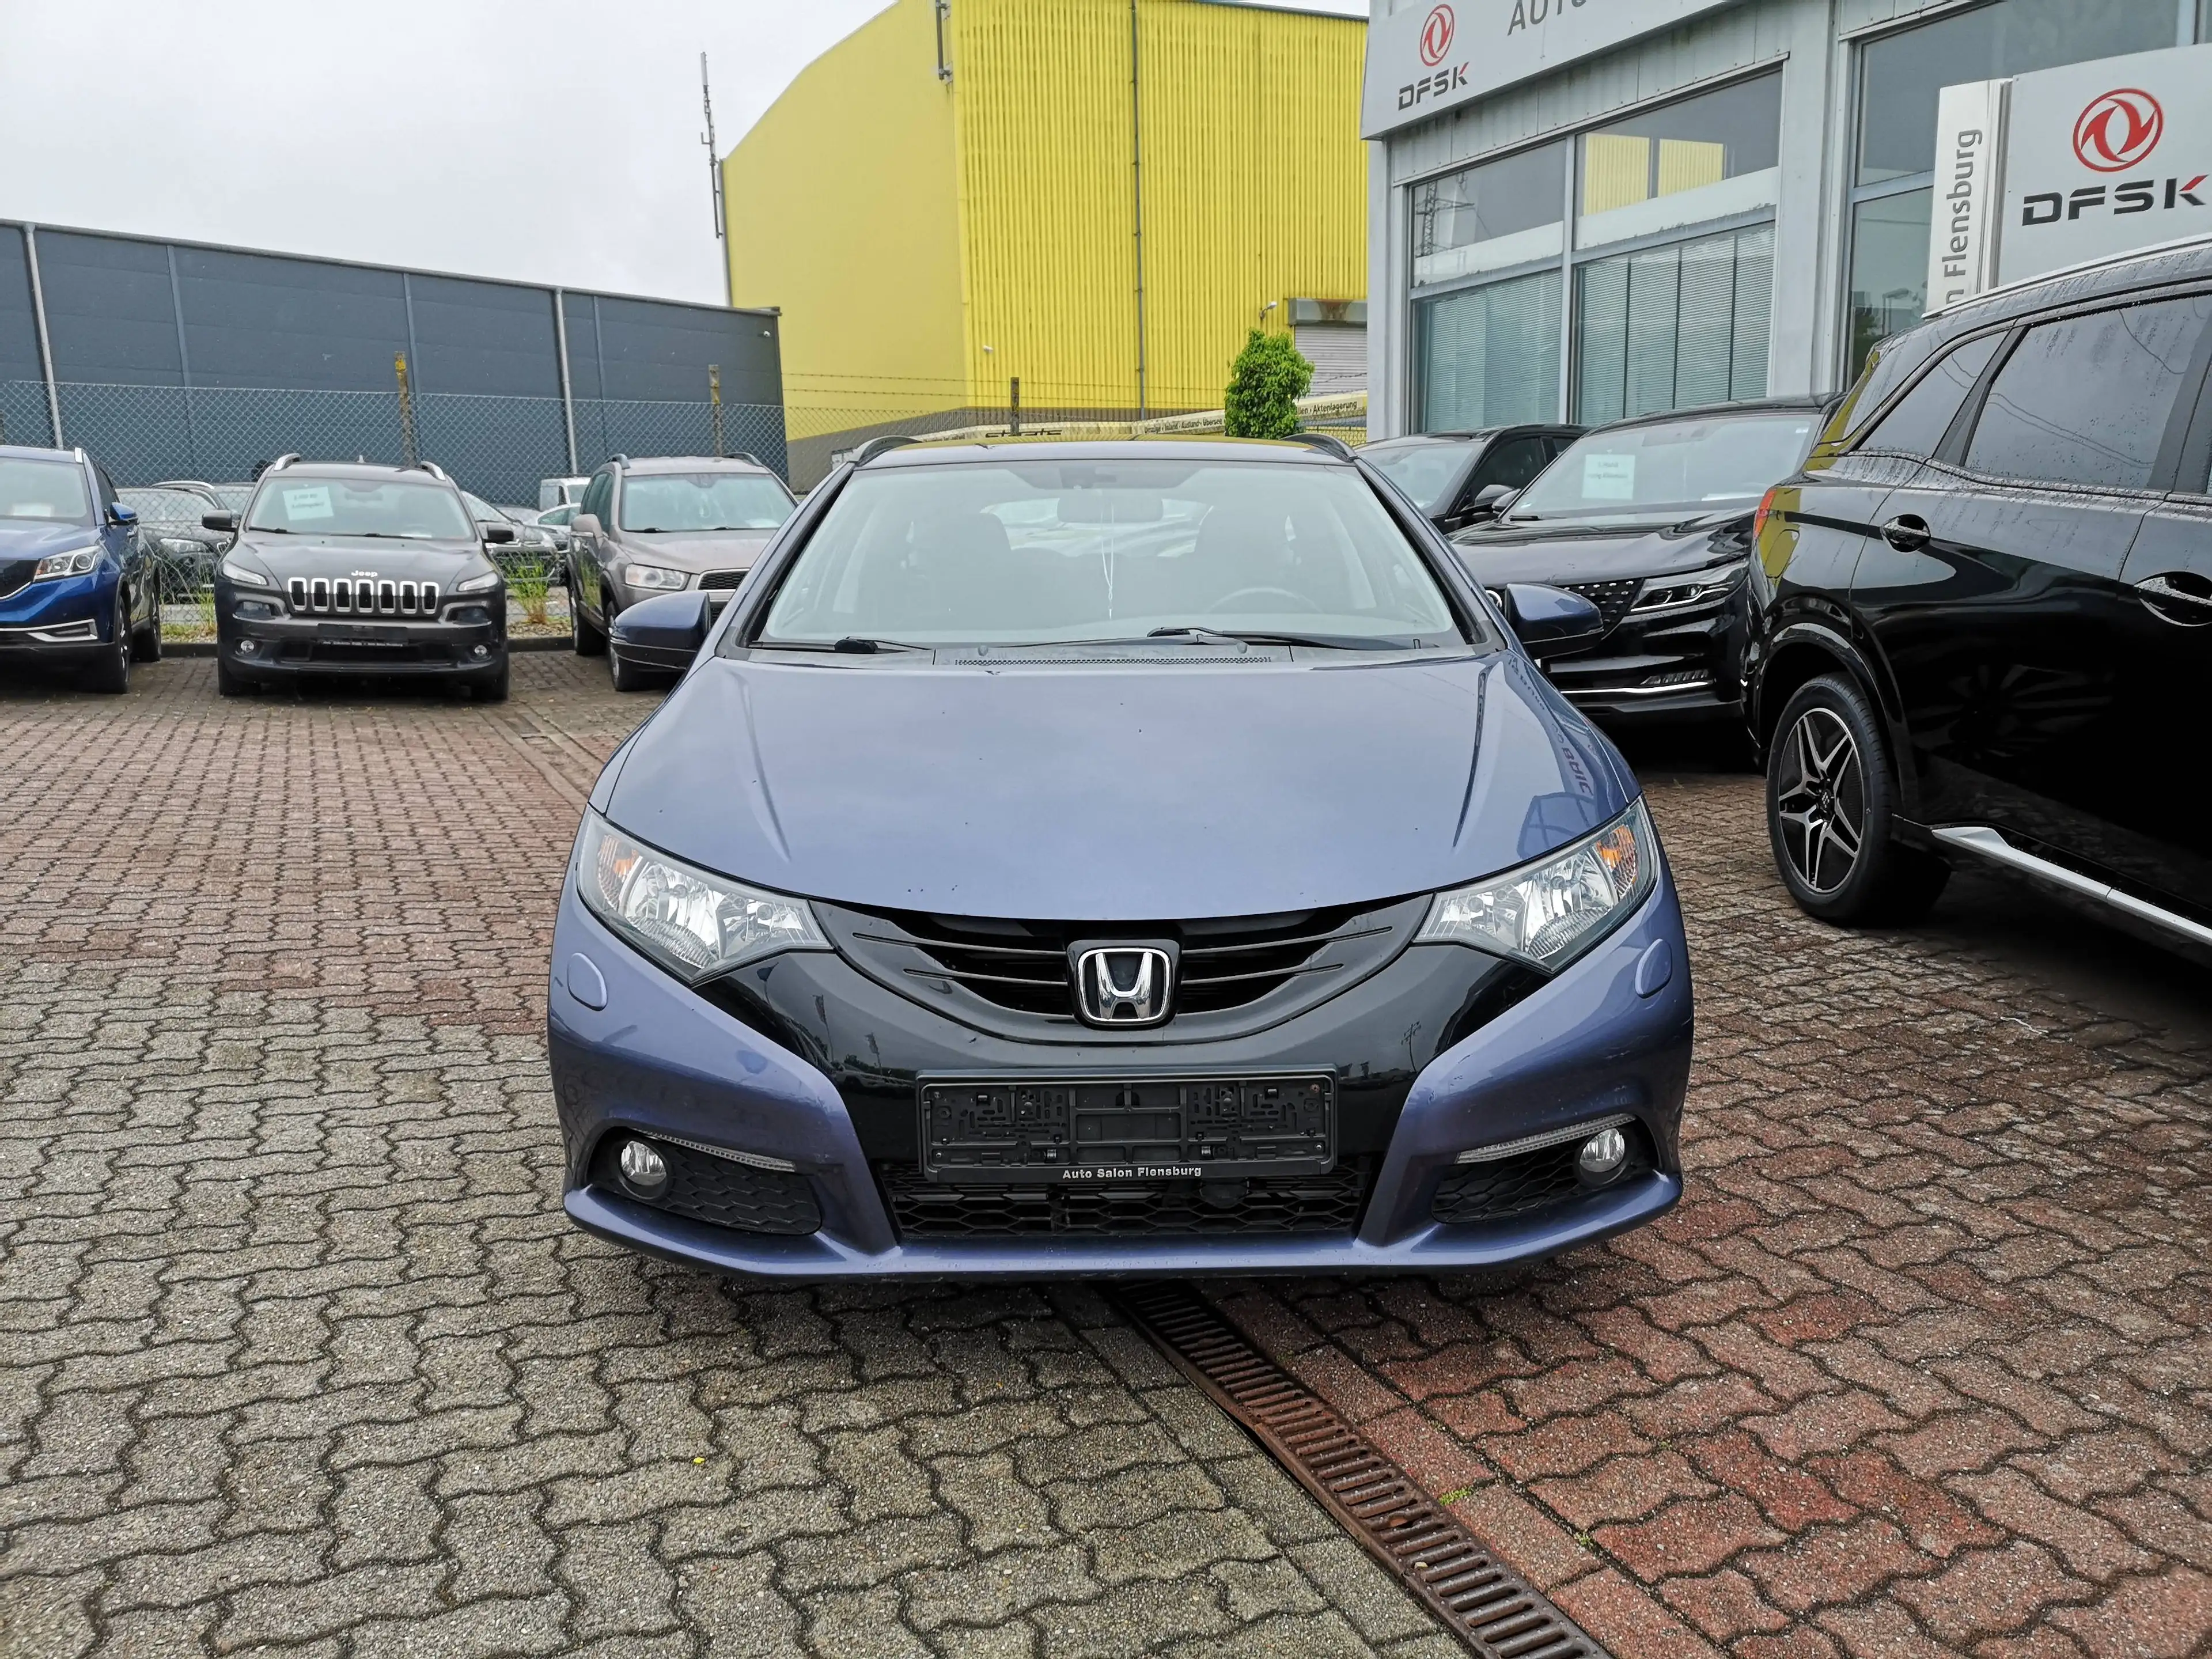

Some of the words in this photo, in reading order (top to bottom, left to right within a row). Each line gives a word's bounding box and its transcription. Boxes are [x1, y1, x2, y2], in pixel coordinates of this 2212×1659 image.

[1507, 0, 1586, 36] AU
[1398, 62, 1469, 111] DFSK
[1942, 129, 1983, 278] Flensburg
[2022, 174, 2210, 226] DFSK
[350, 570, 378, 578] Jeep
[1062, 1169, 1092, 1179] Auto
[1097, 1168, 1132, 1178] Salon
[1137, 1166, 1202, 1177] Flensburg
